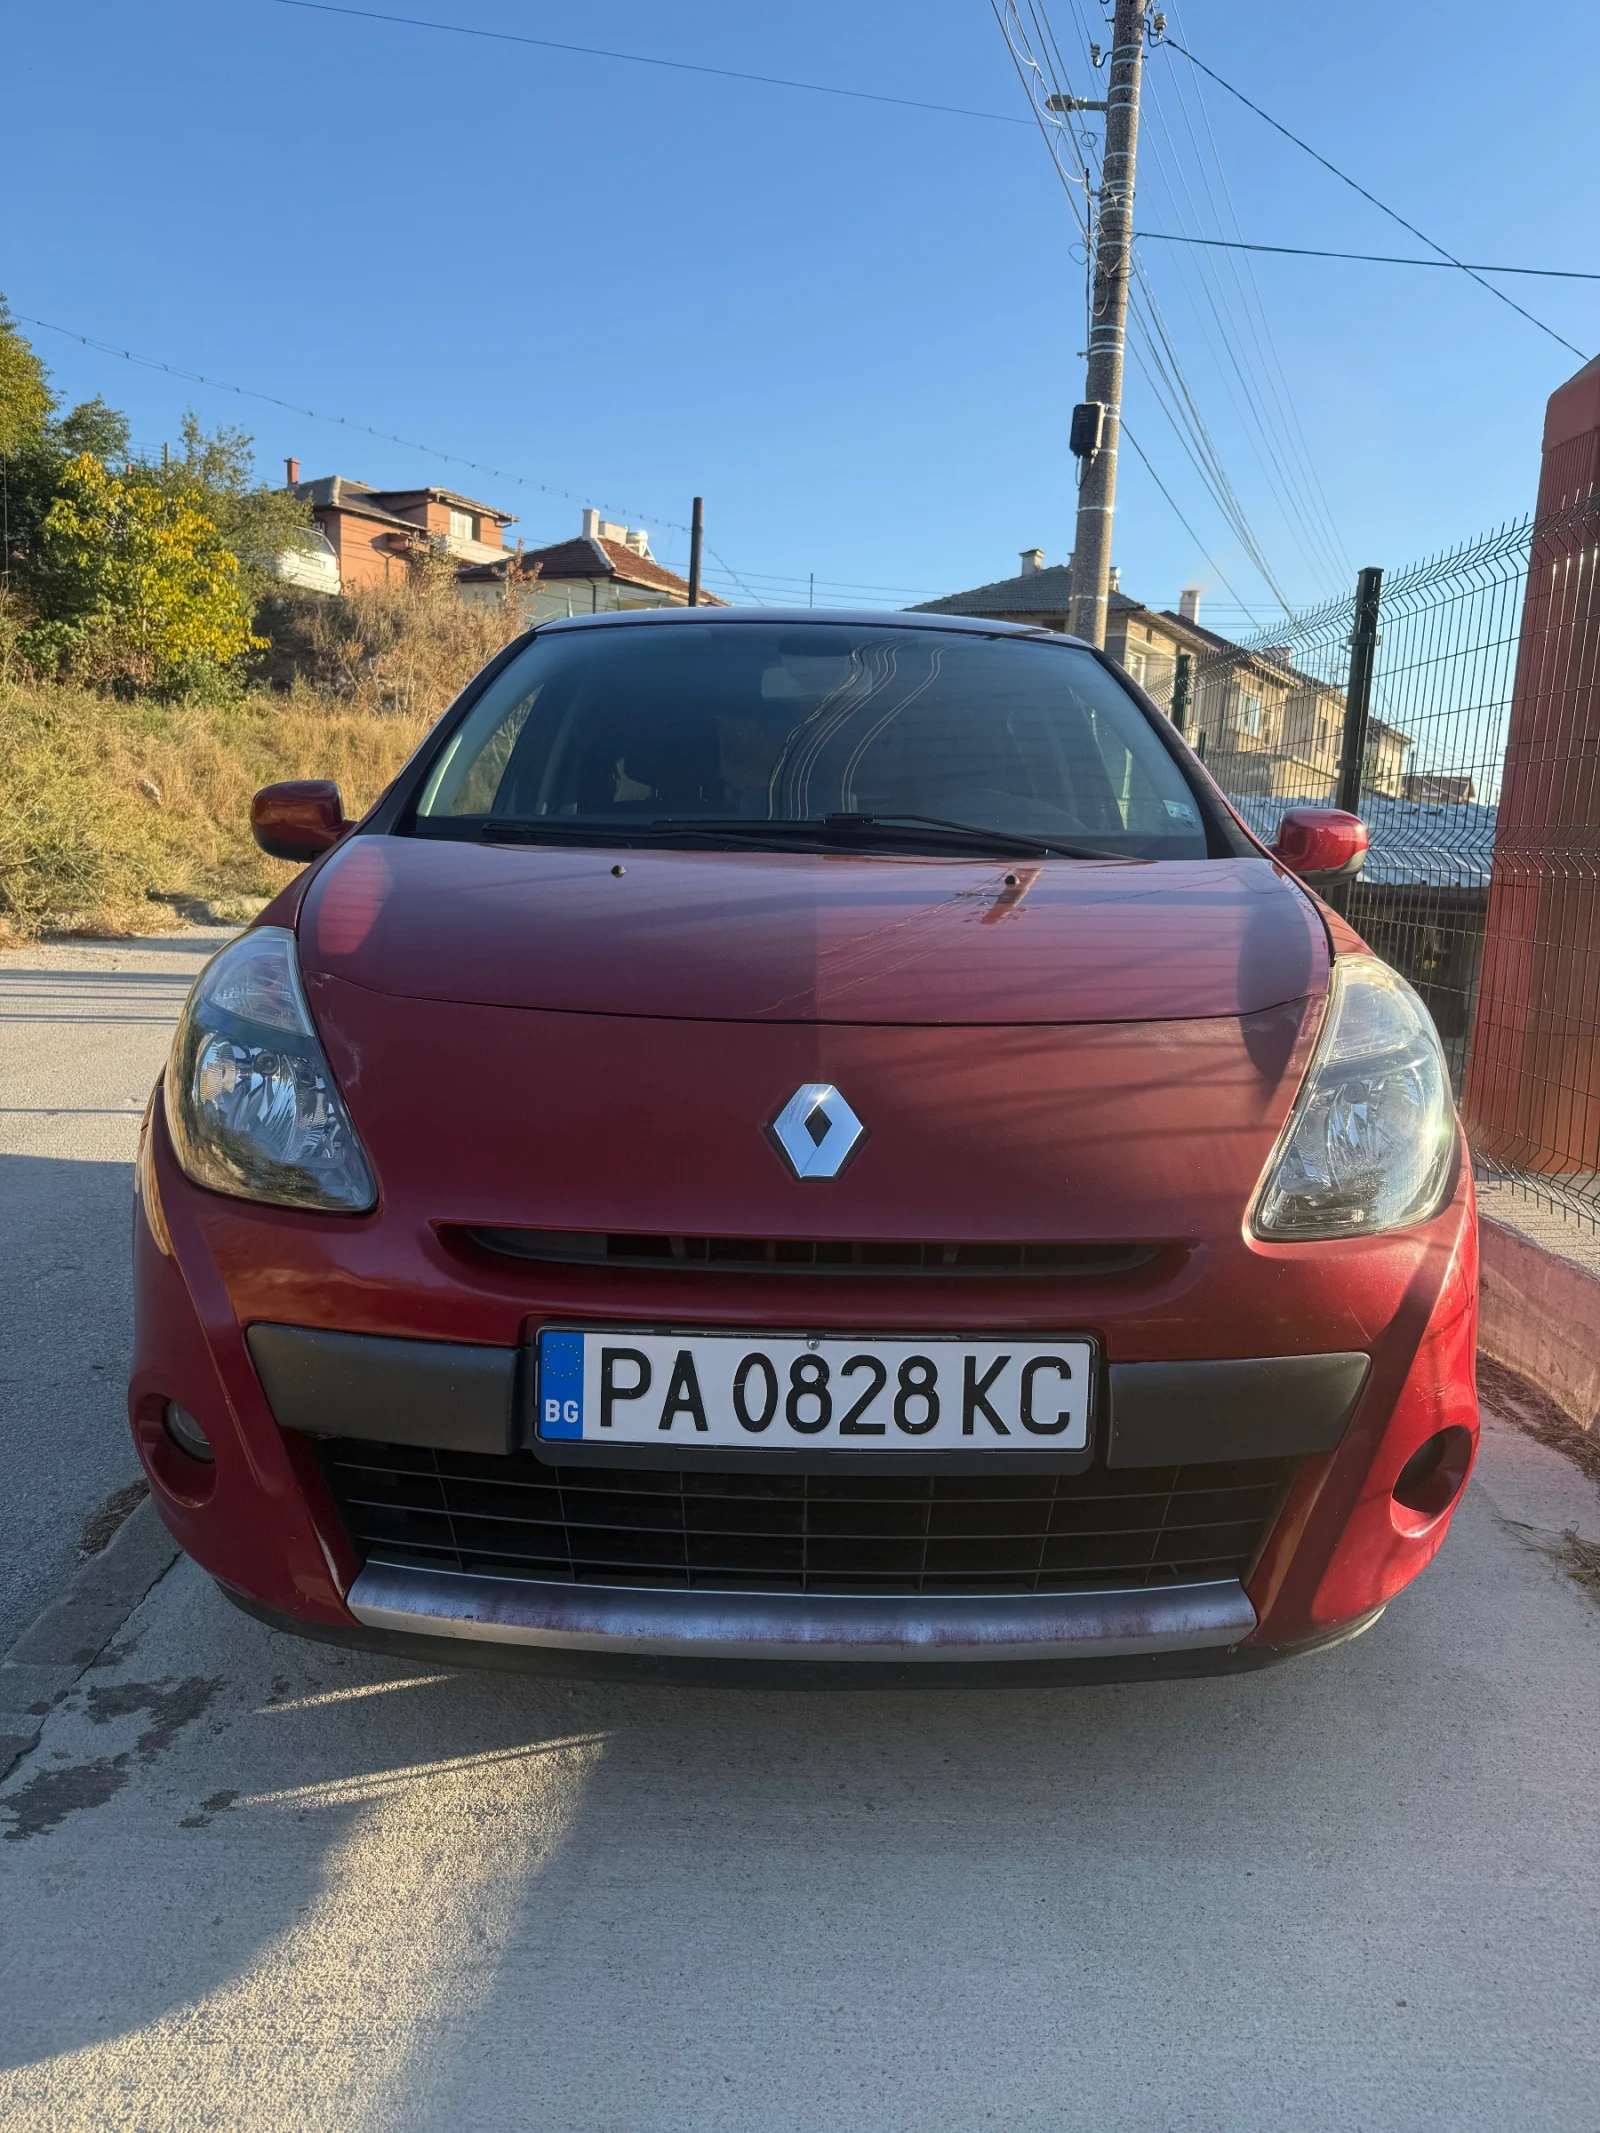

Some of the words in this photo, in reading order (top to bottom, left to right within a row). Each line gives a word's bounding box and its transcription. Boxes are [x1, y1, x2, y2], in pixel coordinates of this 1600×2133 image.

[545, 1399, 579, 1424] BG
[600, 1347, 709, 1432] PA
[732, 1352, 940, 1435] 0828
[962, 1355, 1072, 1435] KC
